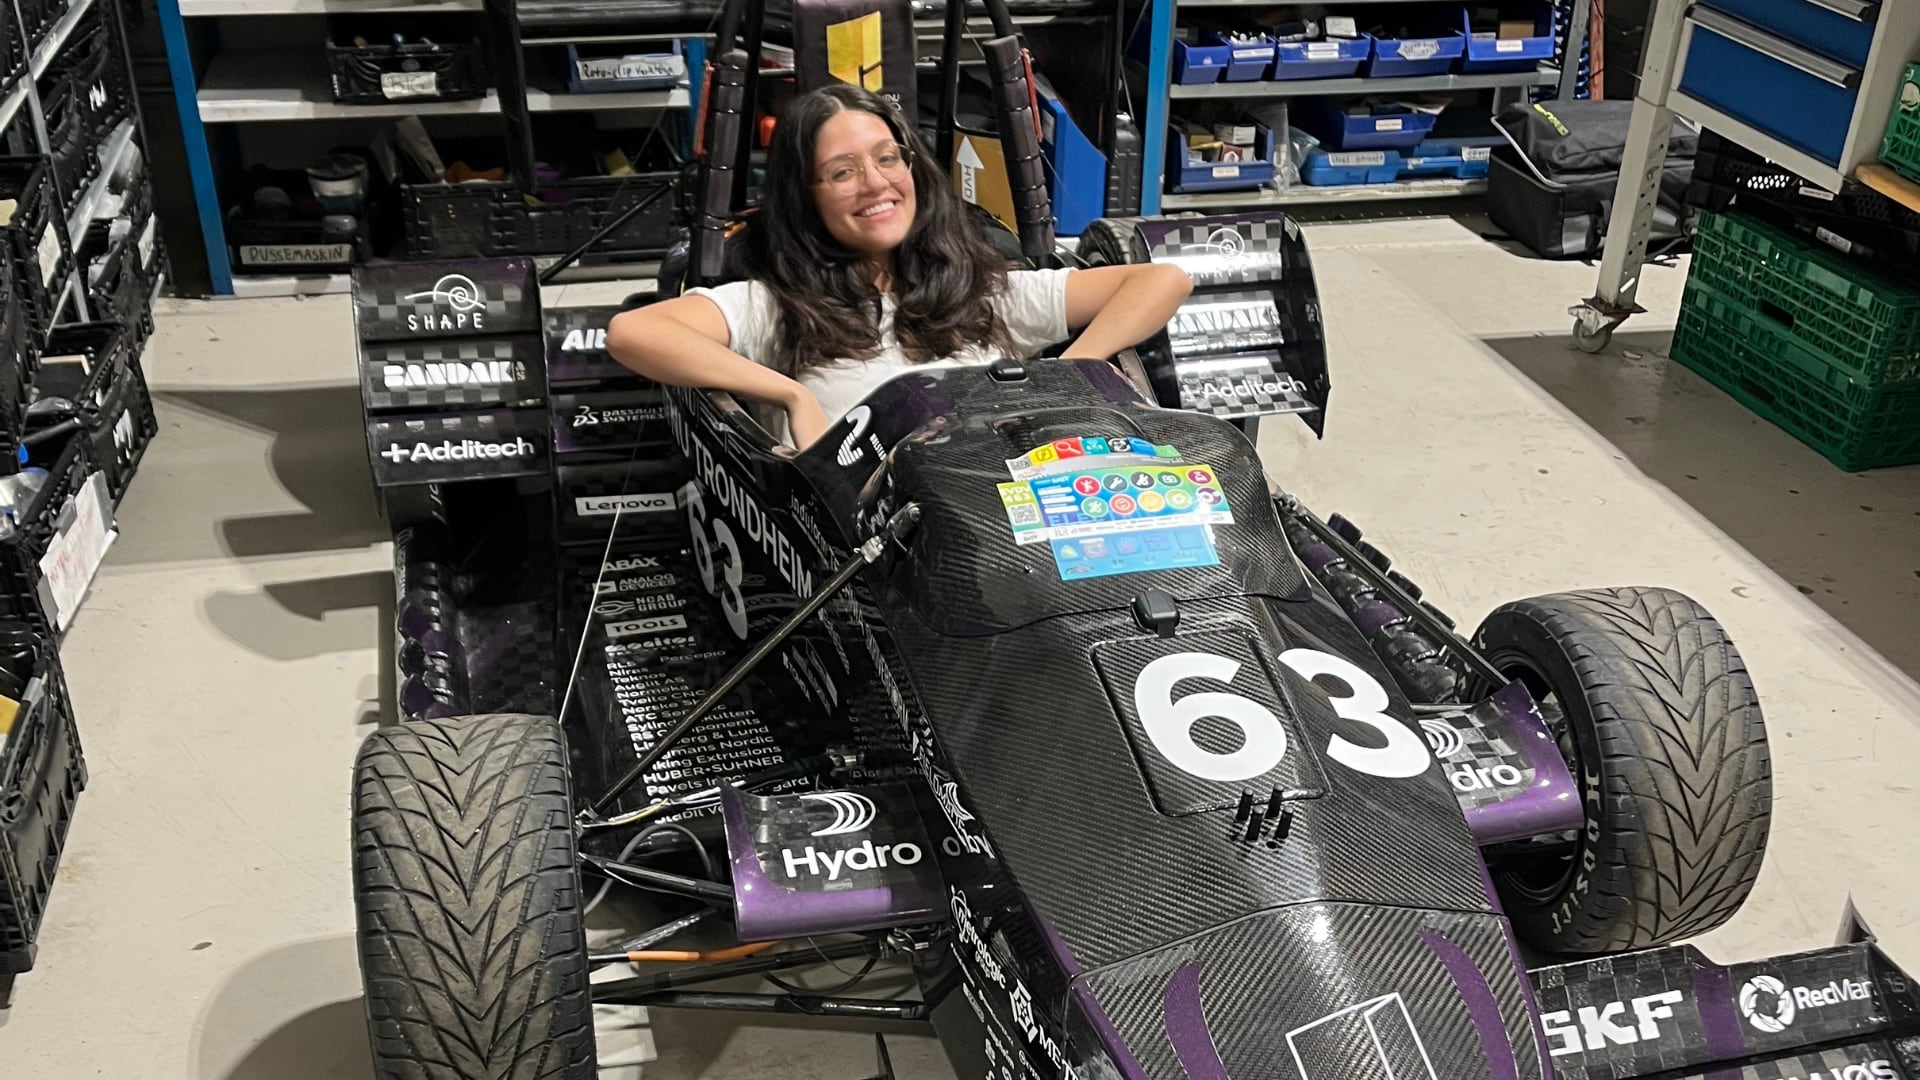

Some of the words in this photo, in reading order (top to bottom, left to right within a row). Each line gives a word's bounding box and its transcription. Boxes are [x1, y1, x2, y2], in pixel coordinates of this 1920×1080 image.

[407, 312, 484, 332] SHAPE
[383, 361, 514, 388] BANDAK
[602, 406, 665, 417] DASSAULT
[585, 498, 667, 512] Lenovo
[691, 431, 813, 600] TRONDHEIM
[602, 556, 660, 572] ABAX
[619, 573, 674, 586] ANALOG
[619, 579, 677, 591] DEVICES
[636, 593, 675, 605] NCAB
[638, 598, 687, 611] GROUP
[612, 618, 679, 633] TOOLS
[610, 672, 666, 683] Teknos
[671, 689, 707, 699] CNC
[621, 702, 679, 715] Norske
[1134, 647, 1432, 783] 63
[625, 712, 658, 724] ATC
[728, 725, 769, 738] Lund
[719, 736, 775, 749] Nordic
[696, 745, 782, 764] Extrusions
[1450, 761, 1523, 794] dro
[646, 780, 703, 797] Pavels
[782, 840, 922, 881] Hydro
[1539, 989, 1684, 1057] SKF
